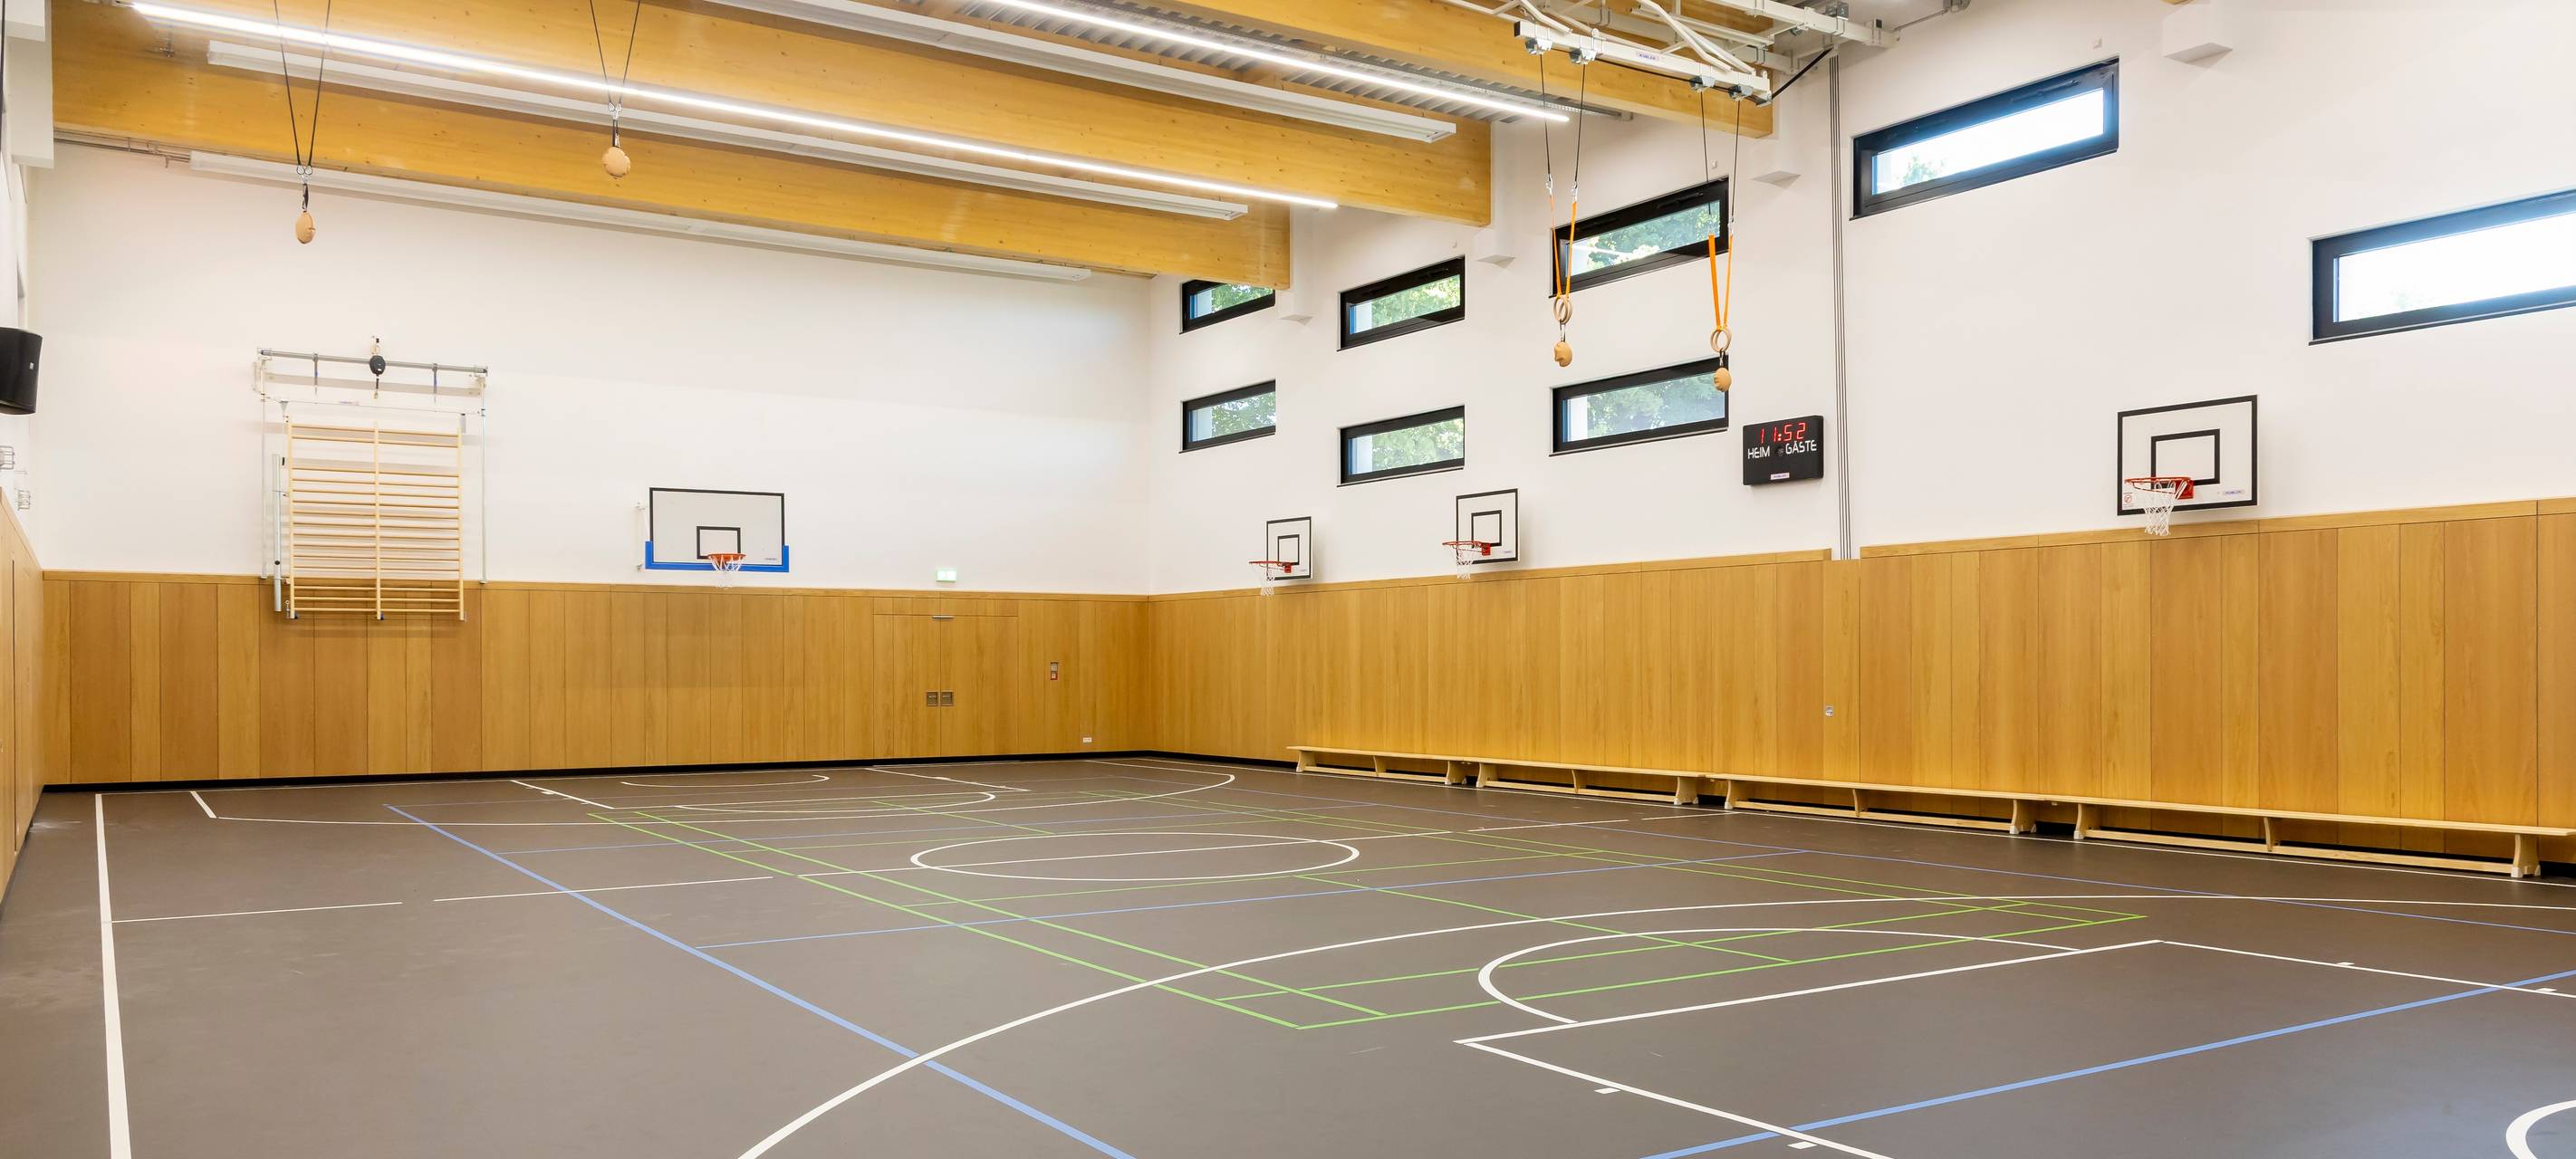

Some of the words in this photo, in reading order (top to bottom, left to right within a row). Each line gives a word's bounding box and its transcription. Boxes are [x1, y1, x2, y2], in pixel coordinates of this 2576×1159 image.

[1760, 423, 1806, 444] 11:52
[1747, 445, 1771, 460] HEIM
[1785, 439, 1817, 455] GÄSTE
